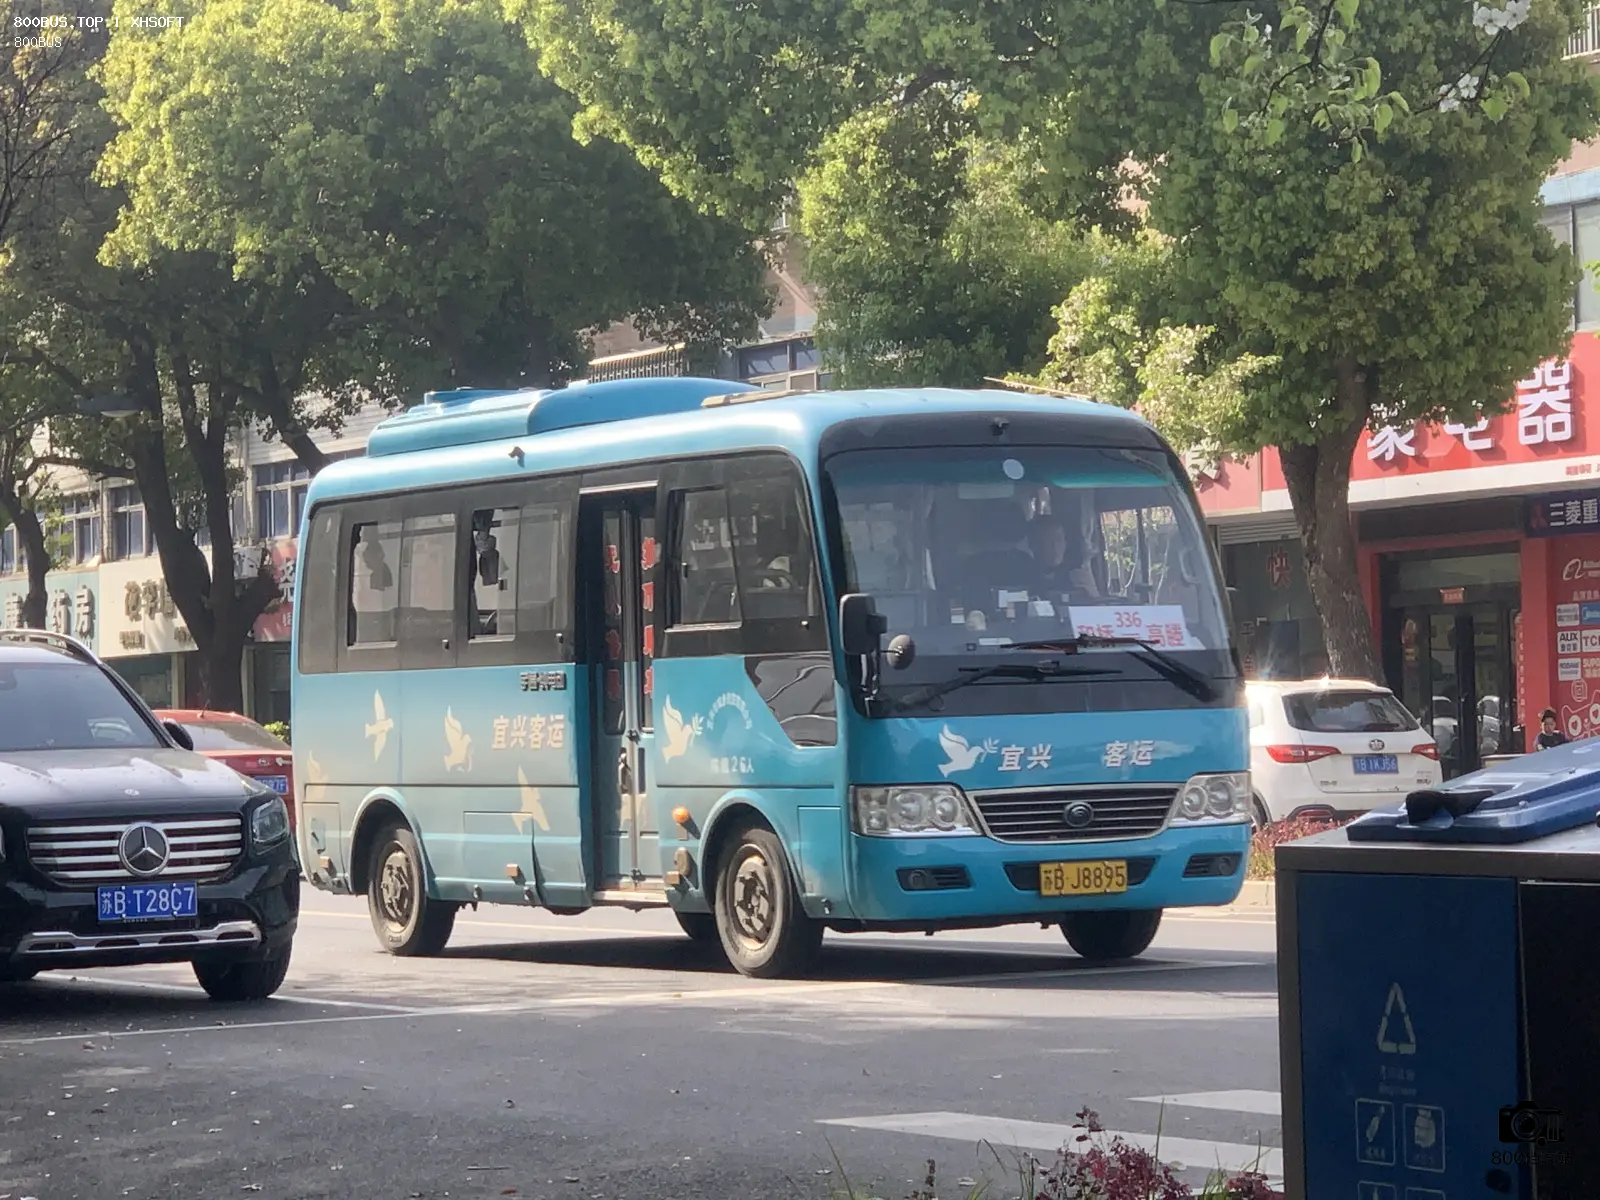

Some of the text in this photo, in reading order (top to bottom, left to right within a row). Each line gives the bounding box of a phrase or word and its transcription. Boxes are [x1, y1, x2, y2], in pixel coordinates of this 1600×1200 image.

[1549, 498, 1600, 527] 三菱重
[1115, 612, 1142, 628] 336
[1559, 632, 1578, 642] AUX
[491, 714, 565, 749] 宜兴客运
[998, 740, 1155, 771] 宜兴 客运
